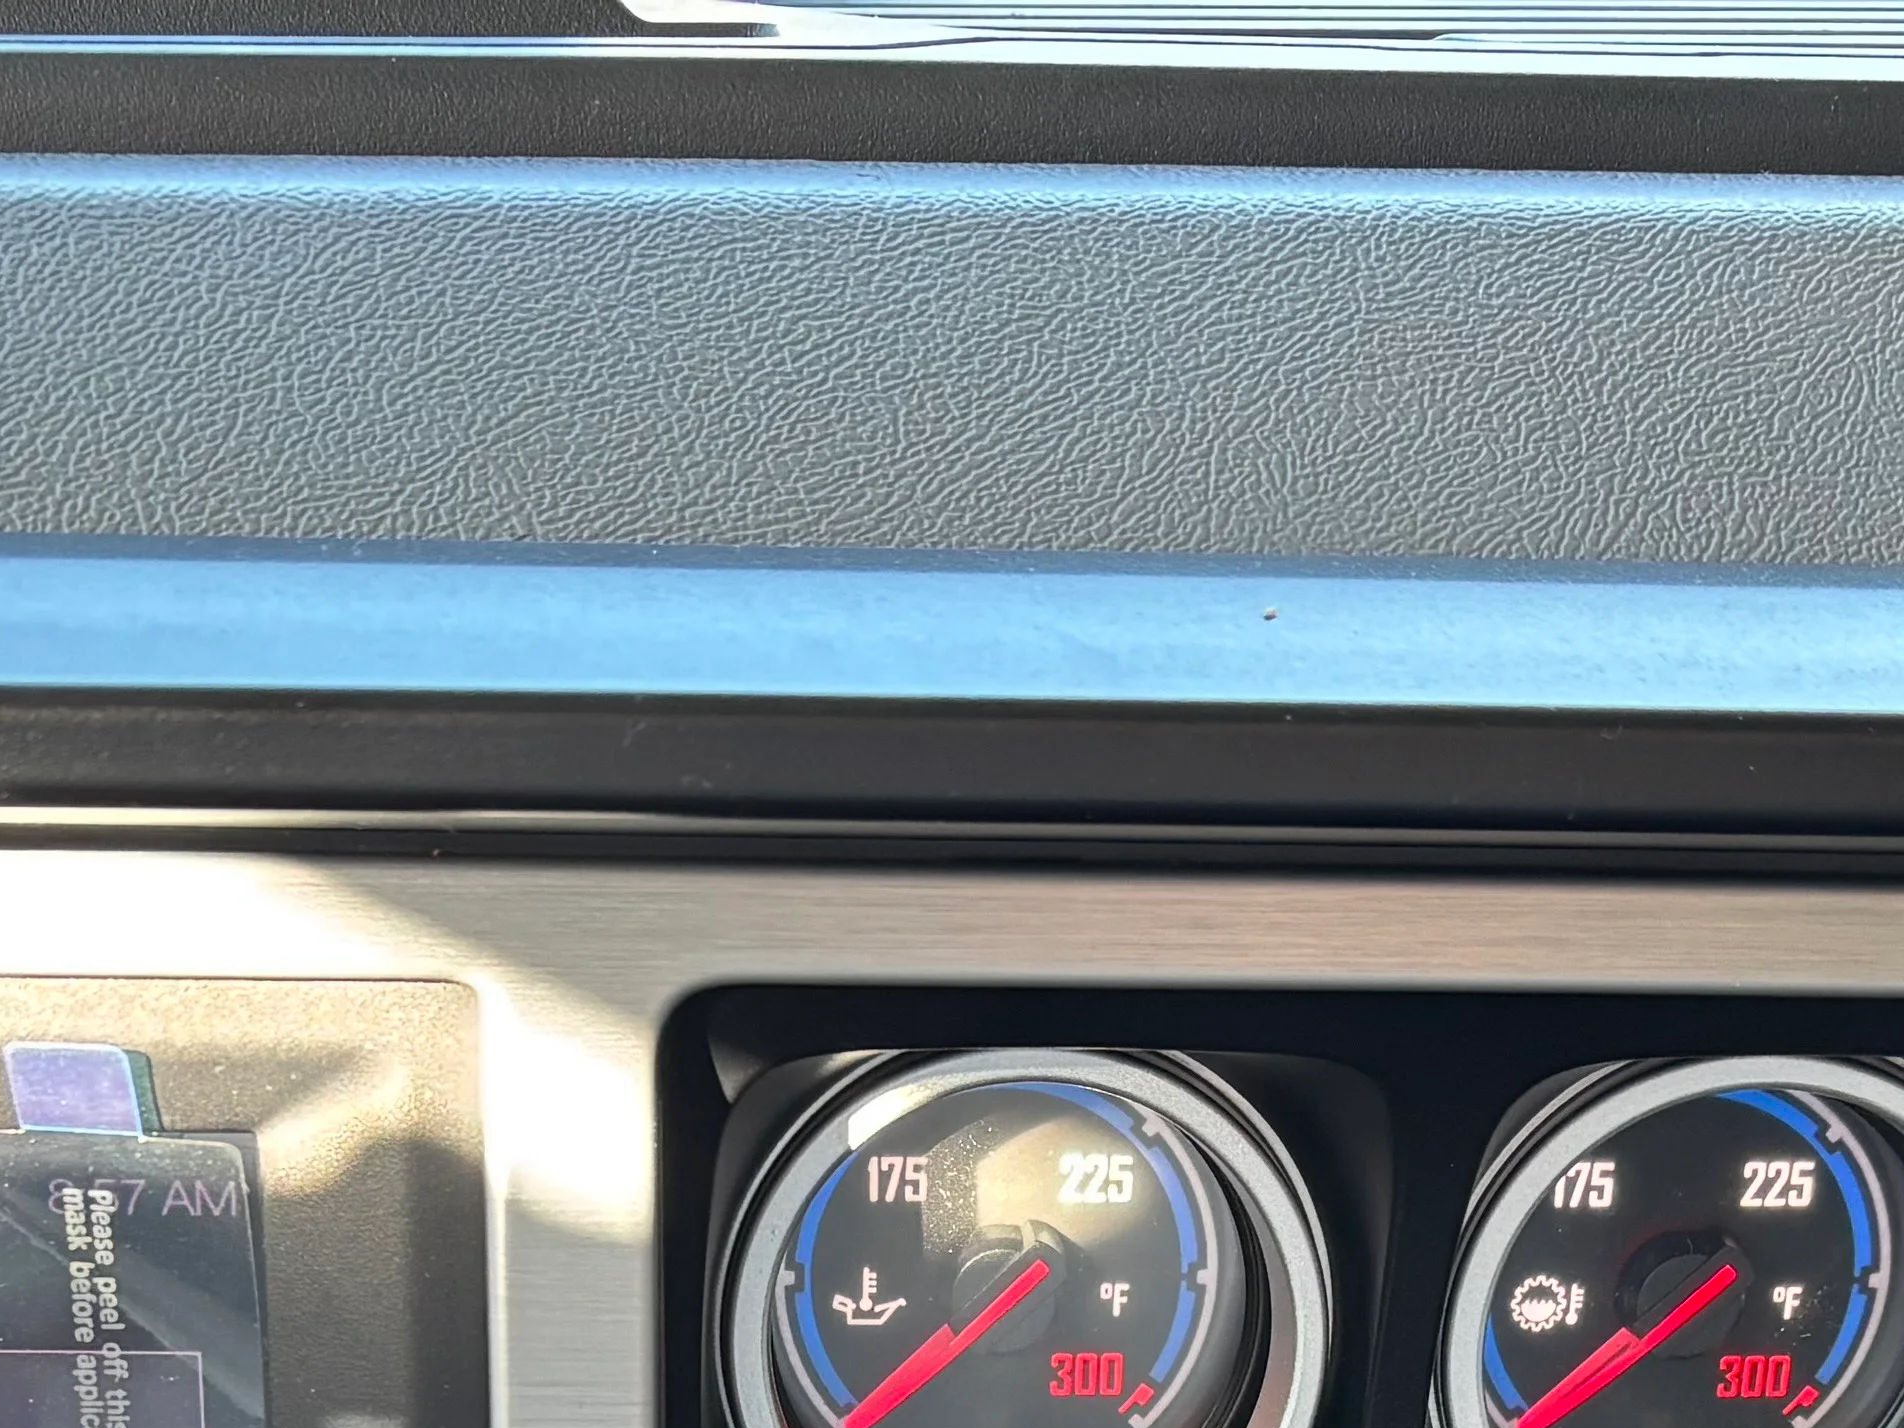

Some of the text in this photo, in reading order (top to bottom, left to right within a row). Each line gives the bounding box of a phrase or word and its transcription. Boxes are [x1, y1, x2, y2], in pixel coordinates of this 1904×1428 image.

[161, 1179, 237, 1216] AM
[867, 1156, 929, 1204] 175
[1056, 1153, 1134, 1204] 225
[1553, 1161, 1616, 1208] 175
[1739, 1160, 1816, 1208] 225
[61, 1187, 93, 1251] mask
[87, 1188, 117, 1266] Please
[68, 1260, 98, 1344] before
[93, 1276, 126, 1331] peel
[101, 1341, 130, 1383] off
[1049, 1352, 1124, 1397] 300
[1716, 1355, 1791, 1400] 300
